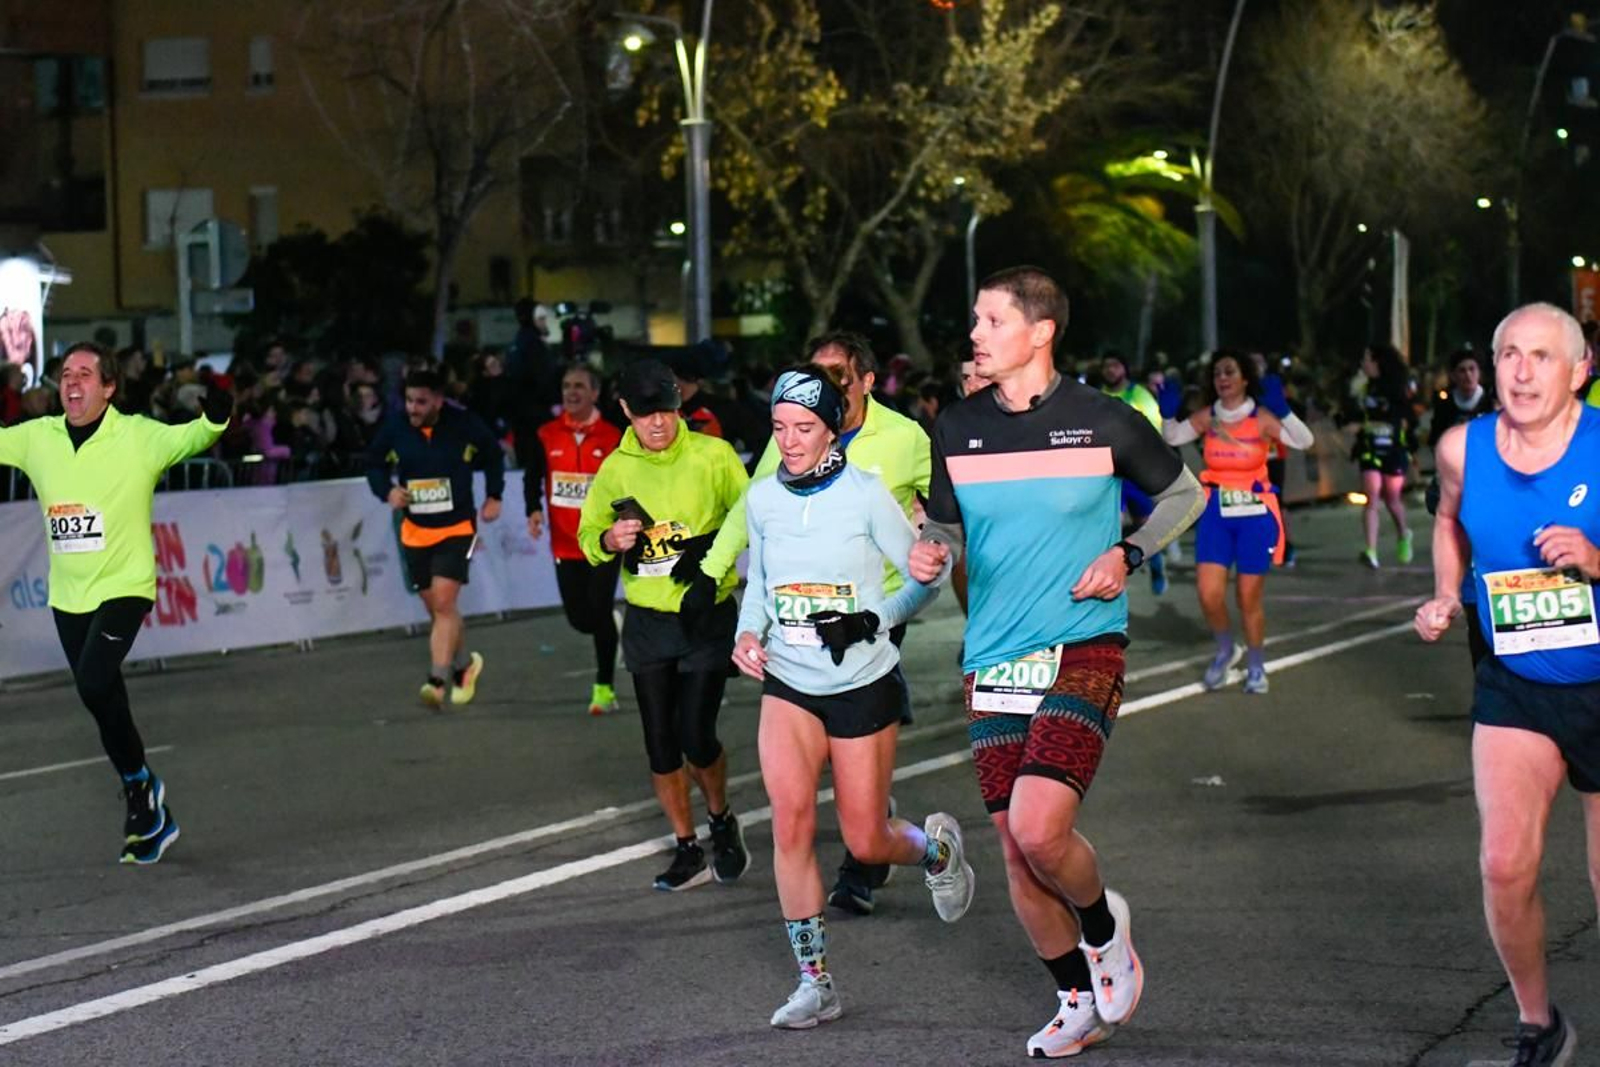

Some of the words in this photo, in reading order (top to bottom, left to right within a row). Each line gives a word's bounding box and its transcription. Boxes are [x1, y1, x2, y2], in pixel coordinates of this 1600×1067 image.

[51, 515, 95, 534] 8037
[1497, 587, 1584, 624] 1505
[982, 663, 1051, 688] 2200
